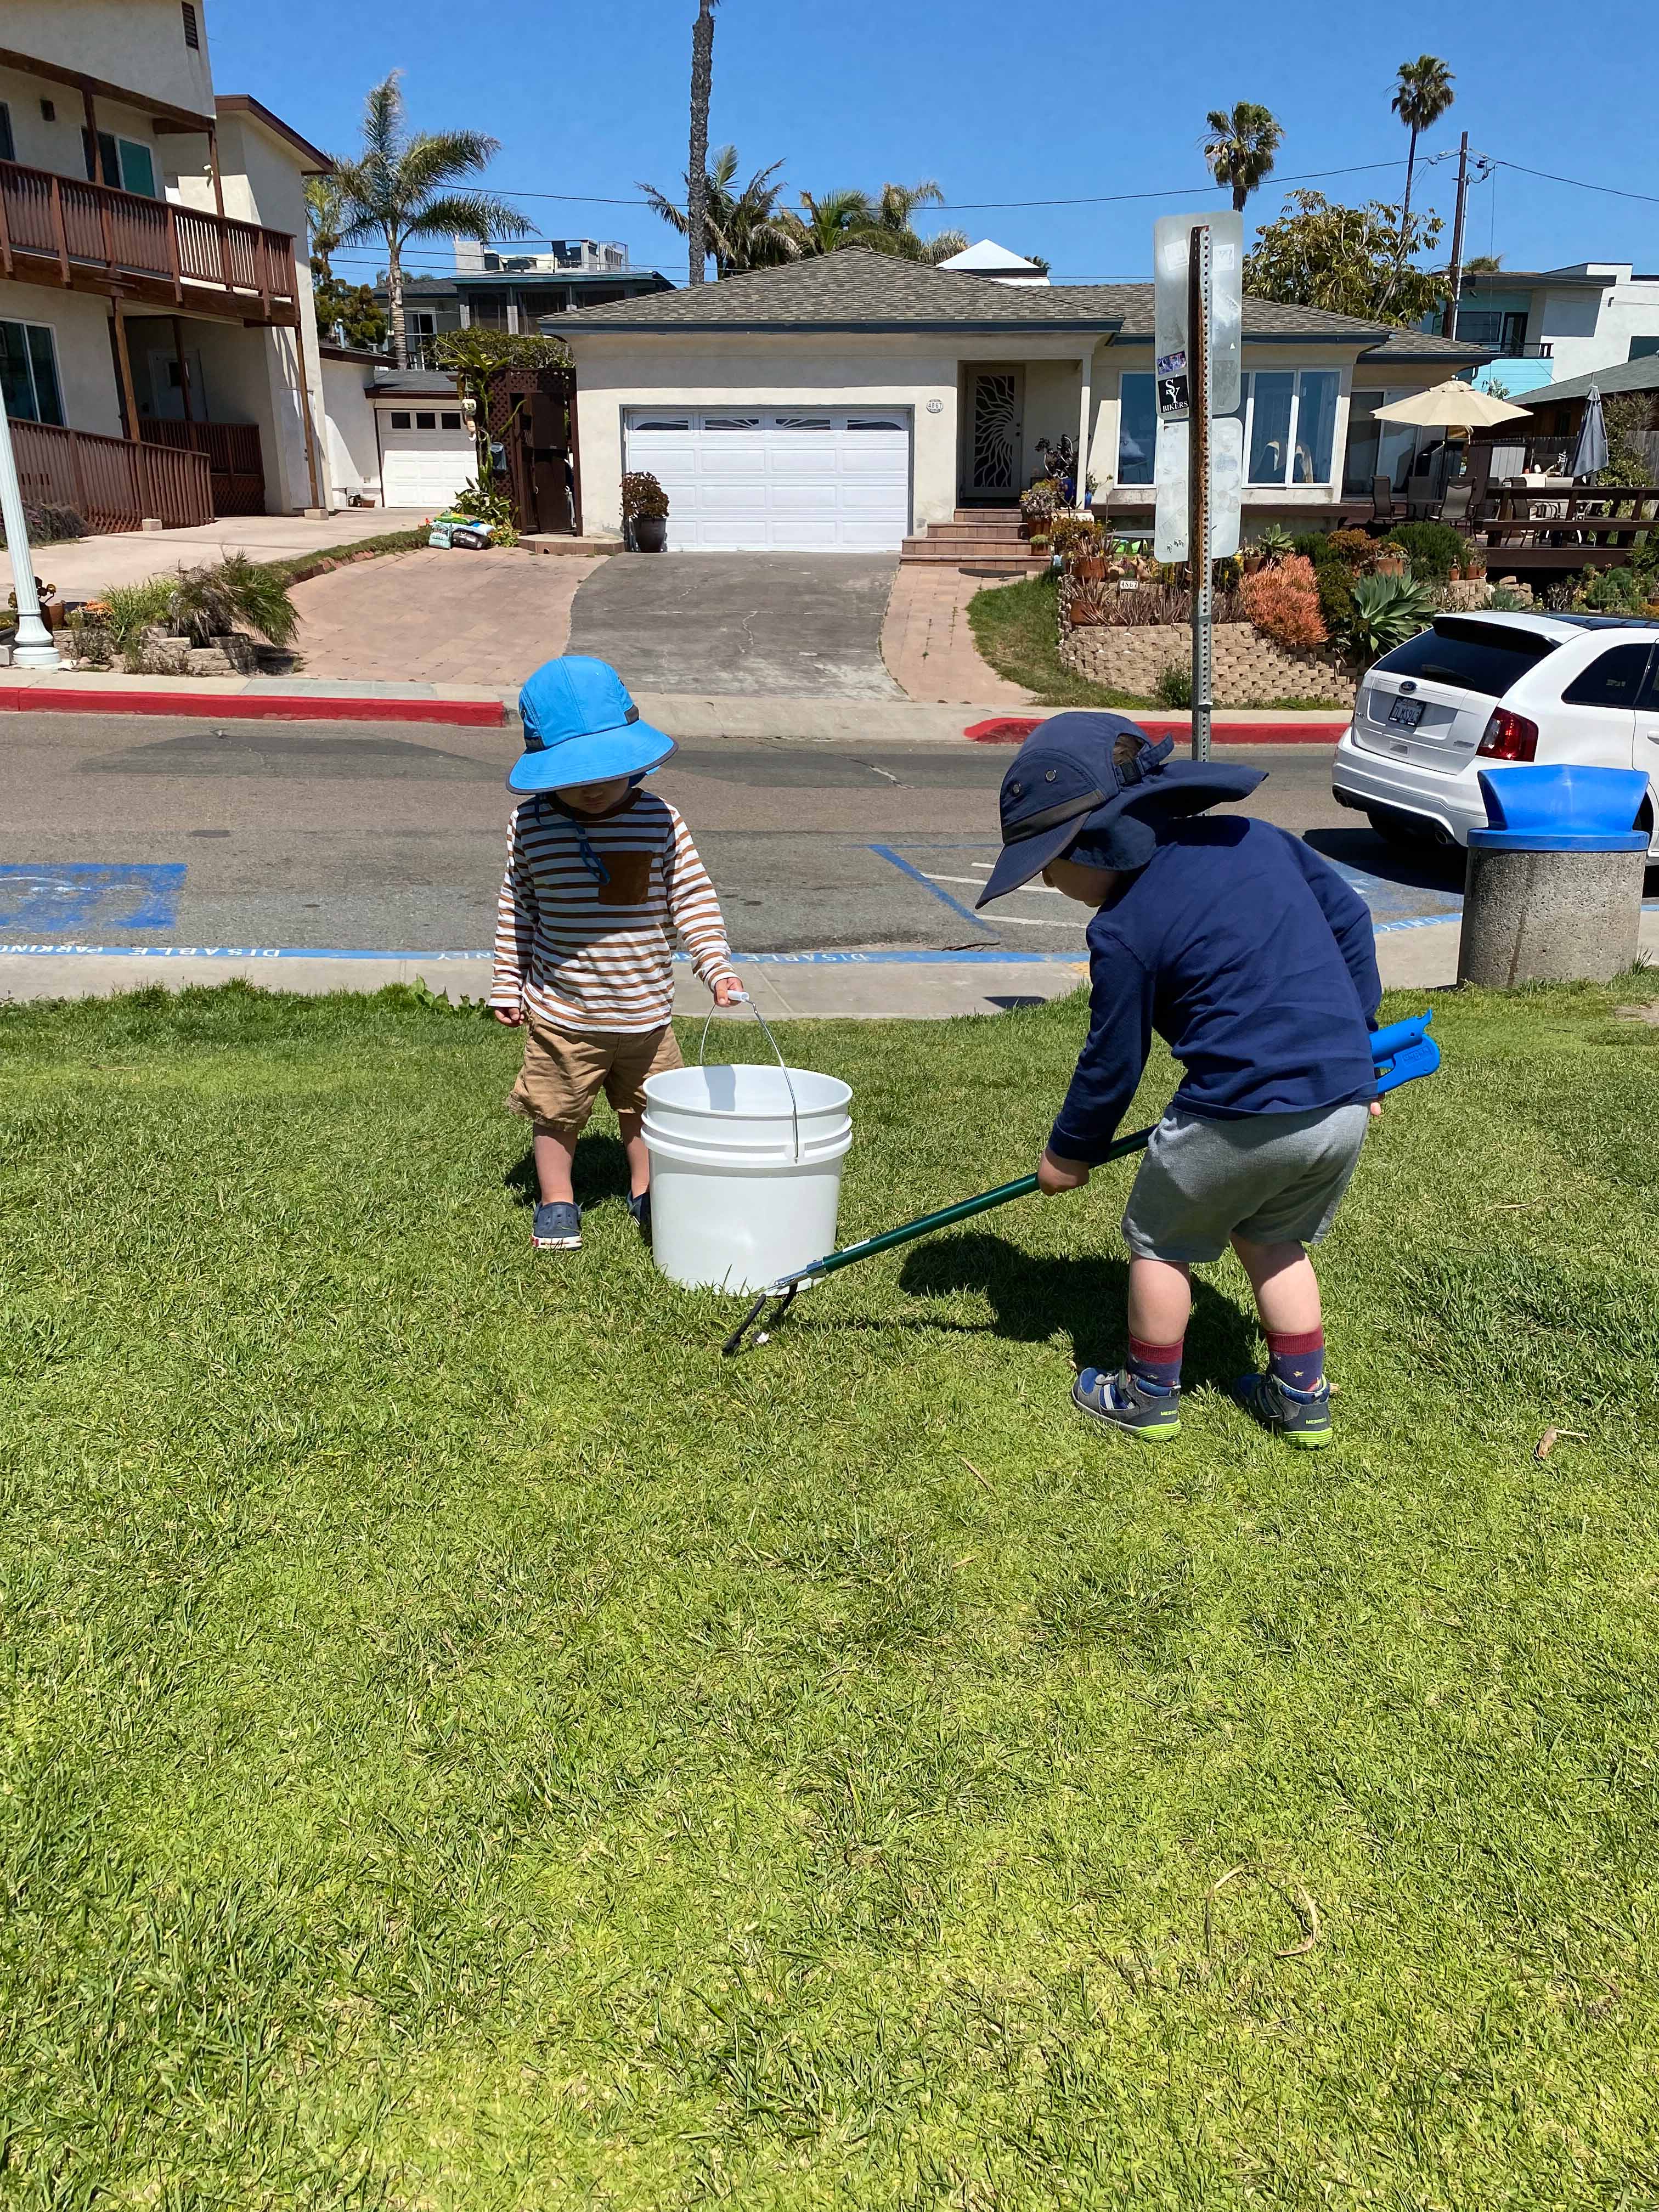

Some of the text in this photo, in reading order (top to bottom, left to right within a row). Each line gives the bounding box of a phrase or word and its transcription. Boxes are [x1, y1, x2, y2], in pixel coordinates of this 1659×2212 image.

[1163, 401, 1188, 413] BIKERS
[1381, 917, 1441, 932] ONLY
[128, 947, 280, 957] DISABLE
[745, 953, 870, 962] DISABLE
